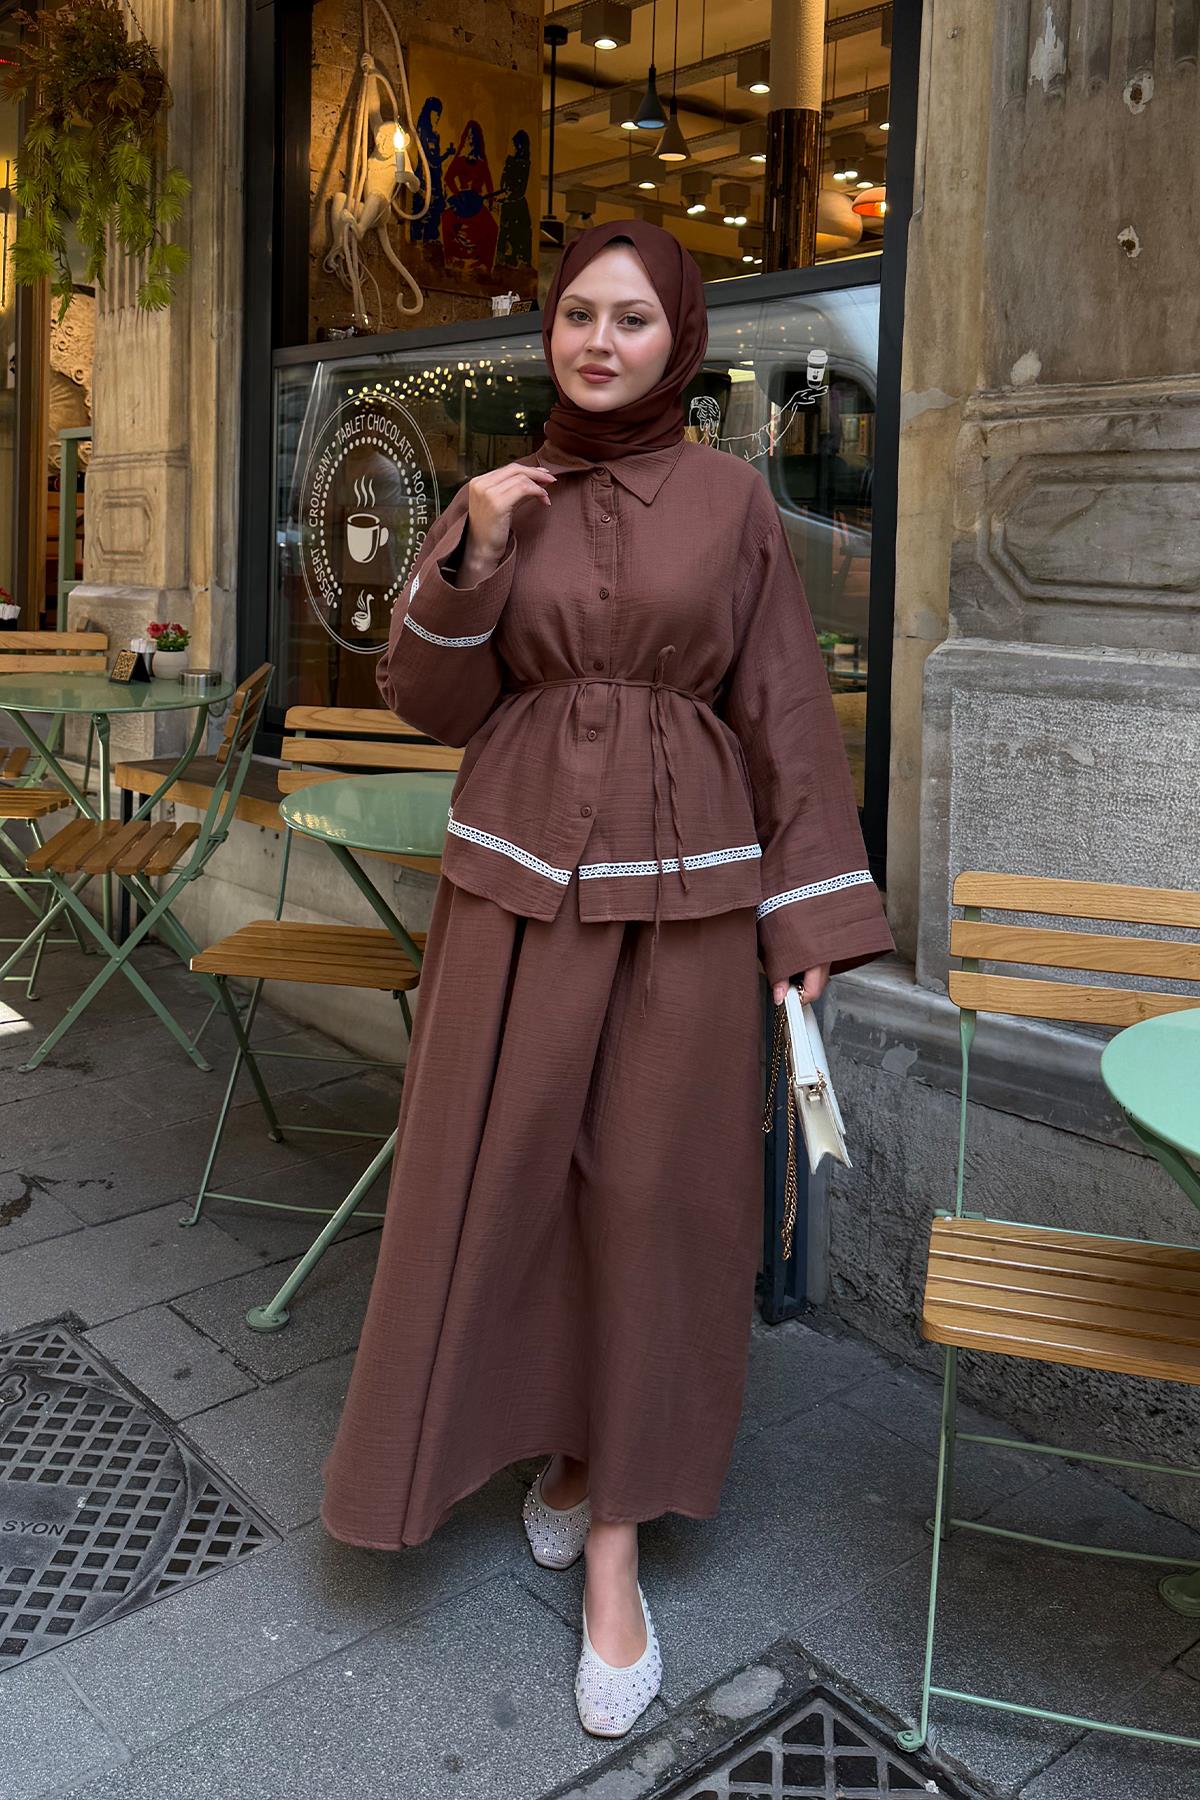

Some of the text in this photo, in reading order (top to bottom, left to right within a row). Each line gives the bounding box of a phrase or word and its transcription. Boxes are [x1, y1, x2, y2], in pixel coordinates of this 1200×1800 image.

[309, 414, 428, 606] DESSERT CROISSANT TABLET CHOCOLATE ROCHE
